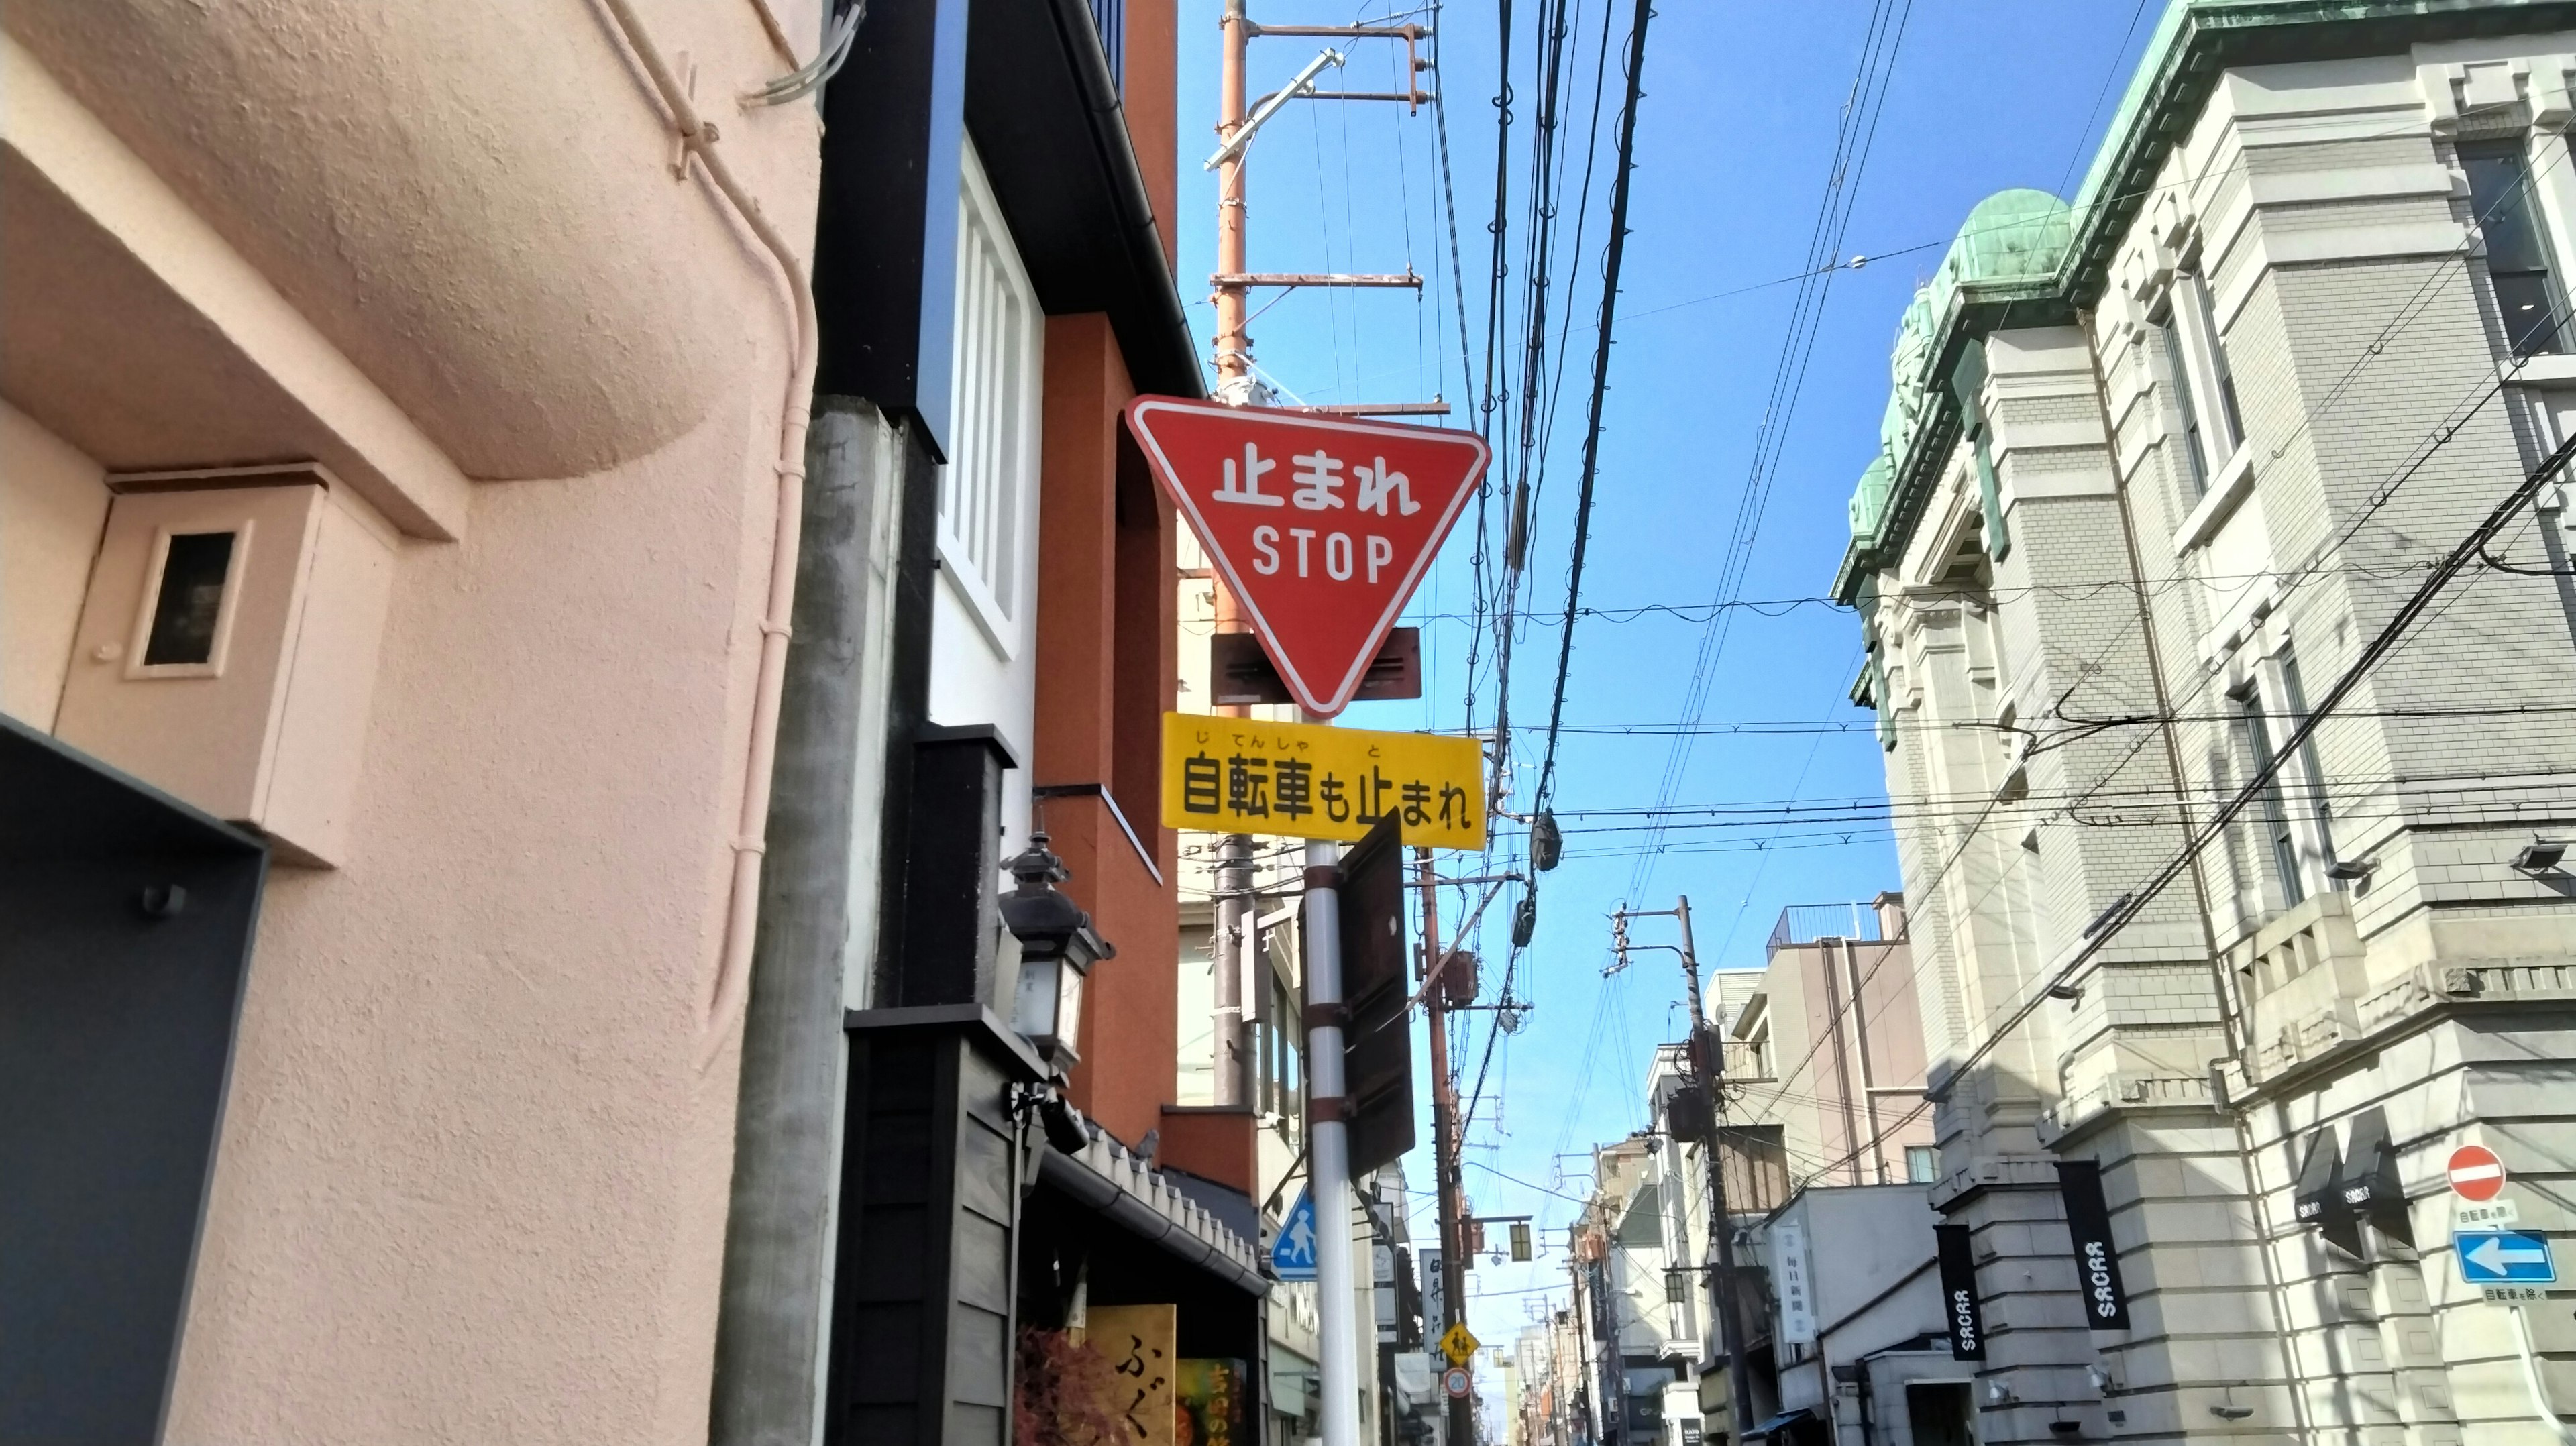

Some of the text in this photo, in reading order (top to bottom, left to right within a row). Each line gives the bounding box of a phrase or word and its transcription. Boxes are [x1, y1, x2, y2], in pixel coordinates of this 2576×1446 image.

[1212, 441, 1421, 517] 止まれ
[1252, 524, 1393, 584] STOP
[1184, 750, 1472, 831] 自転車も止まれ
[2485, 1288, 2544, 1301] 自転車を除く
[1115, 1334, 1165, 1439] ふぐ
[1451, 1376, 1465, 1389] 20
